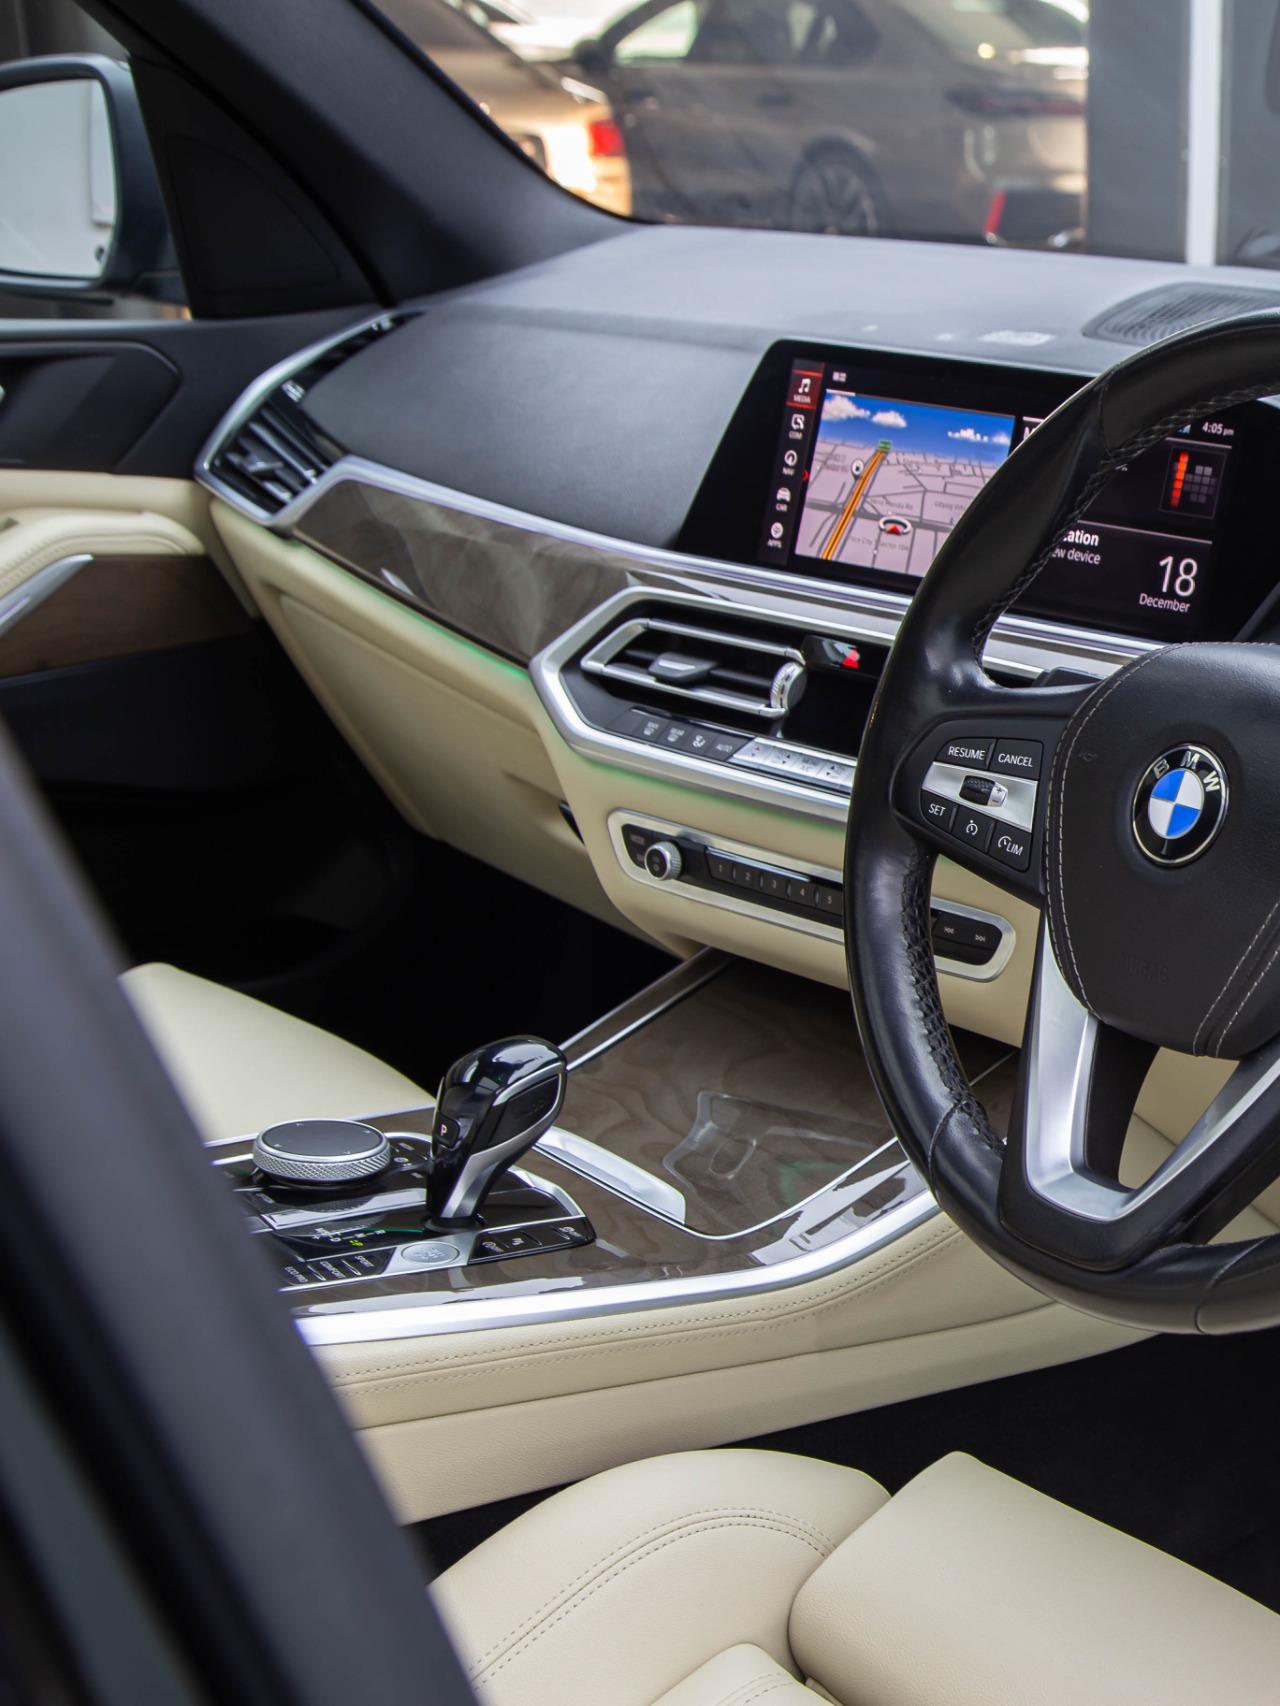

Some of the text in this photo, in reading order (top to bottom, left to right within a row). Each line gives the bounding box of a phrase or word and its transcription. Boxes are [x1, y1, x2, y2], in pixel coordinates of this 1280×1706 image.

[1202, 421, 1234, 436] 4:05 pm
[1063, 530, 1099, 546] ation
[1067, 548, 1101, 564] device
[1159, 555, 1198, 597] 18
[1139, 593, 1191, 613] December
[948, 746, 986, 761] RESUME
[998, 753, 1034, 768] CANCEL
[1154, 750, 1220, 792] BMW
[928, 803, 946, 817] SET
[1006, 842, 1024, 856] LIM
[441, 1125, 448, 1136] P
